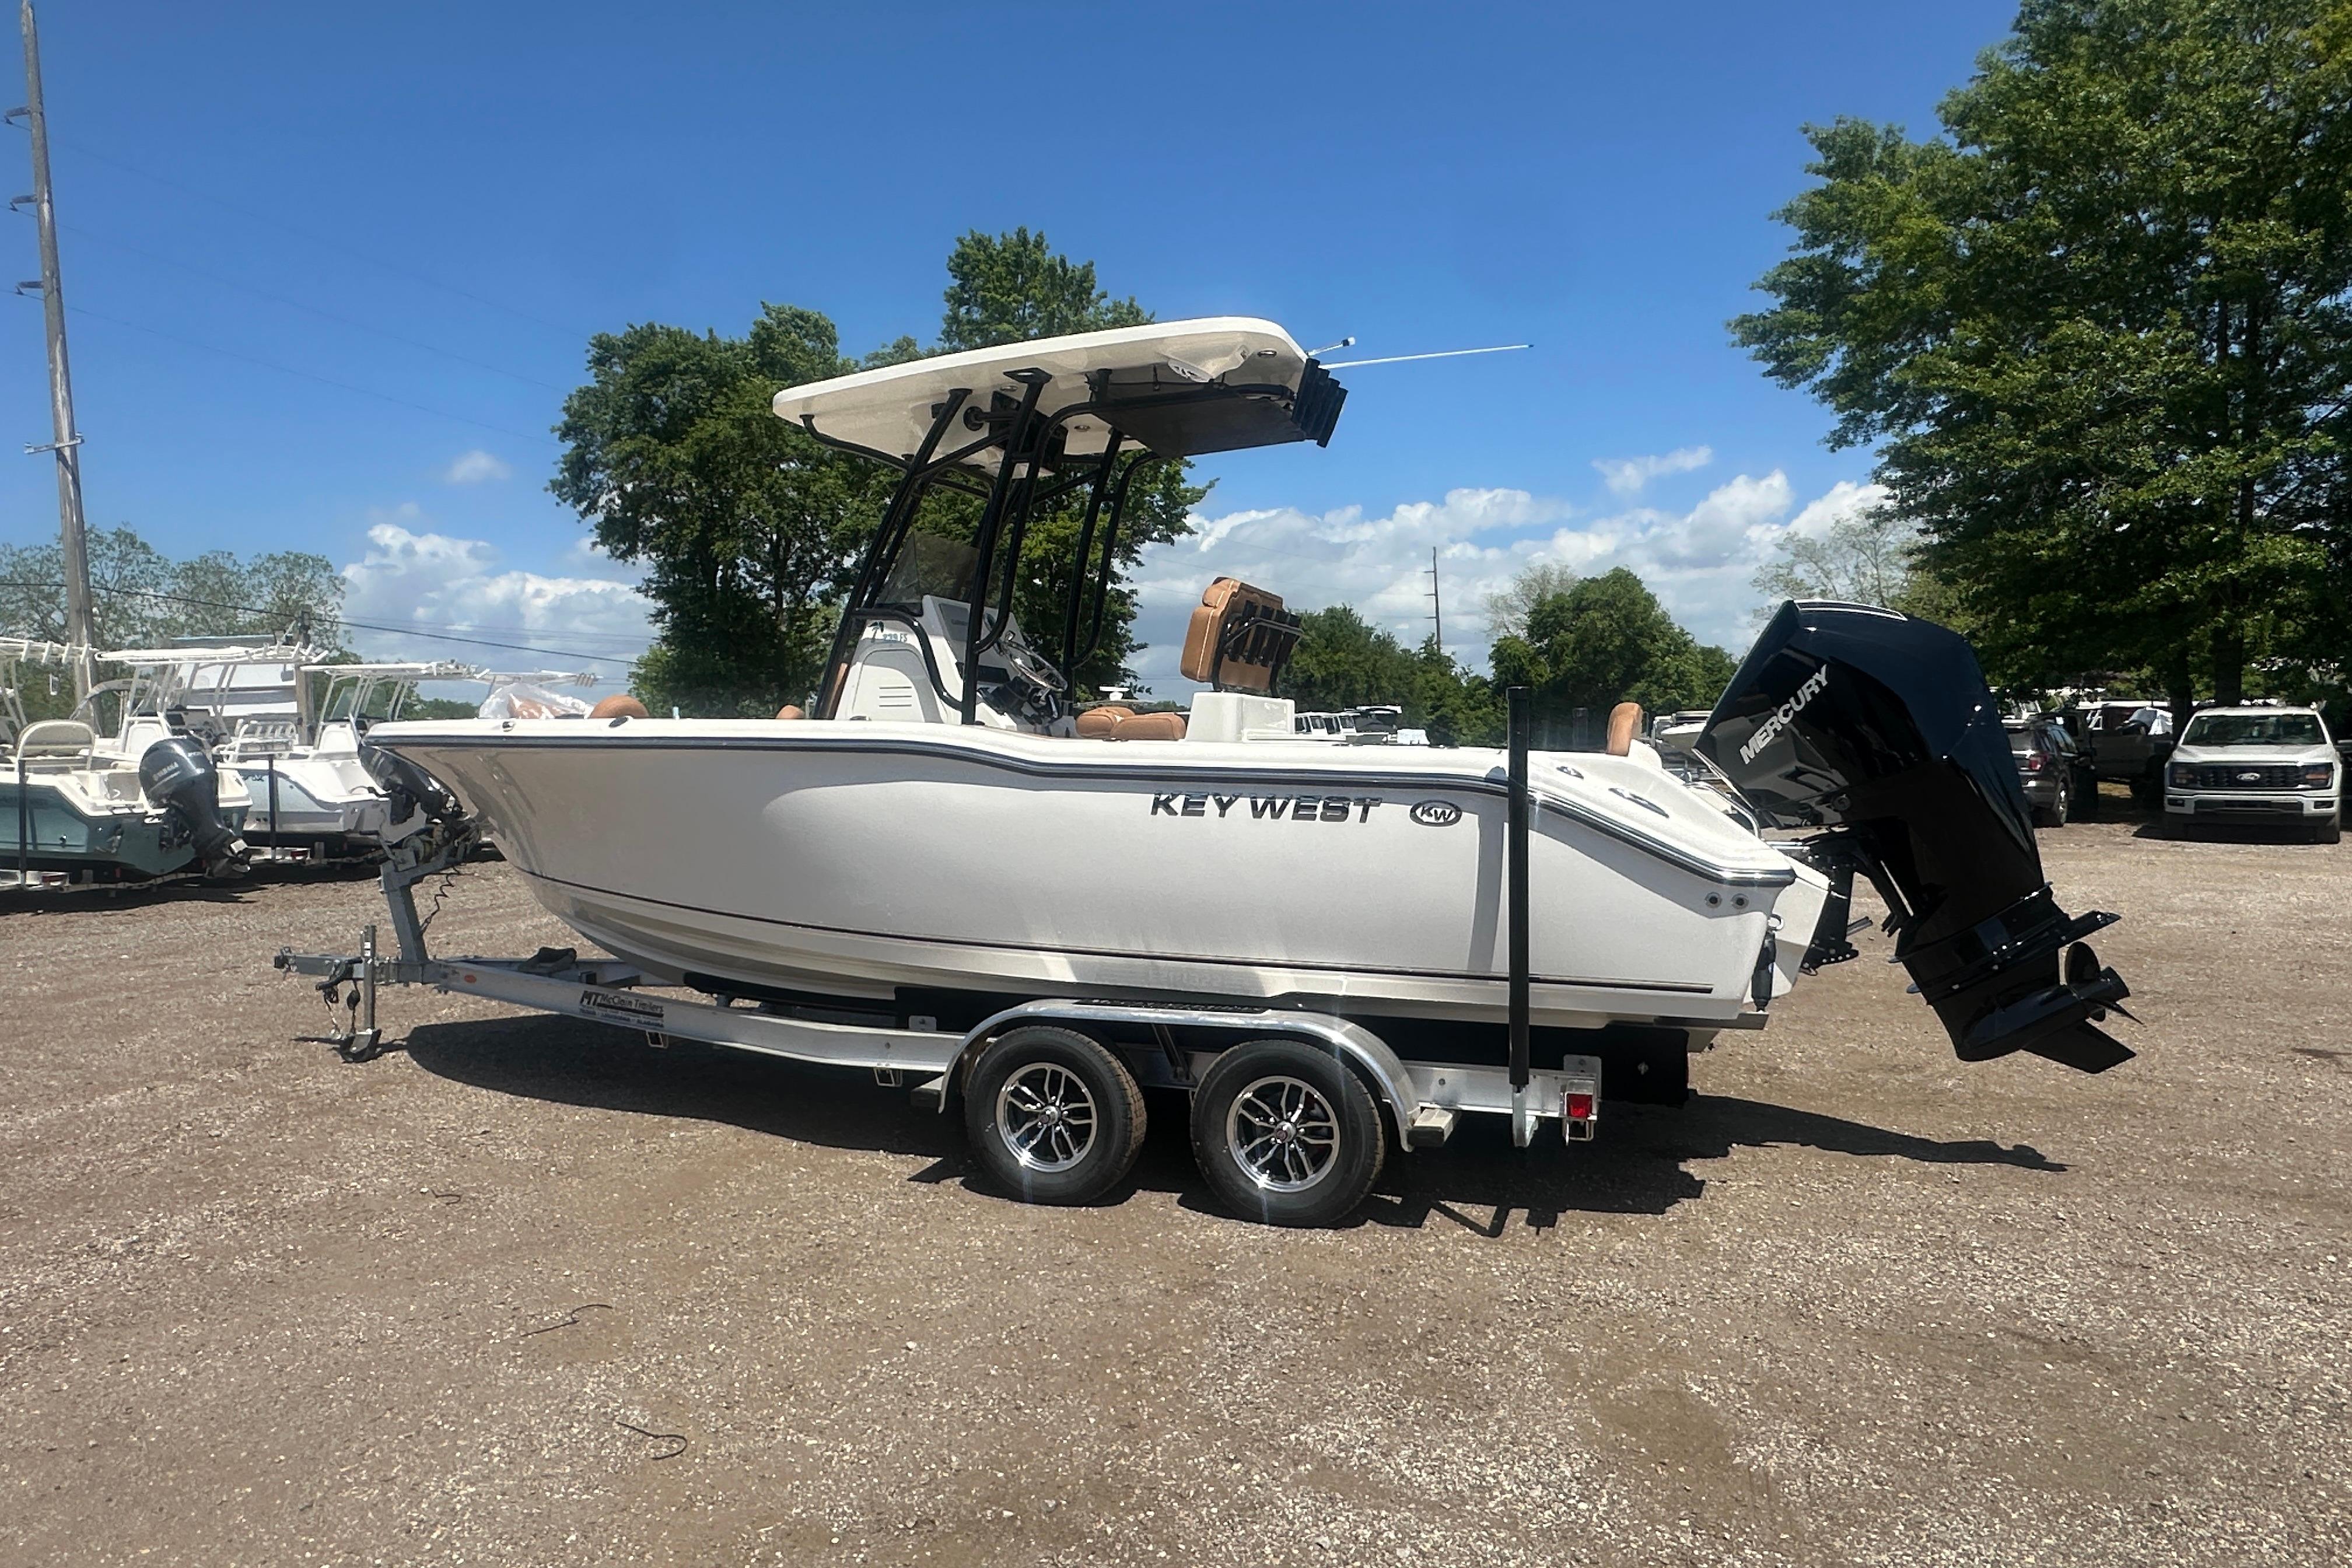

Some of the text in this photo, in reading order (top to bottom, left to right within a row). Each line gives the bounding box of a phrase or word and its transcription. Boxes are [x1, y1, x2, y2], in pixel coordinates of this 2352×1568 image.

[1740, 664, 1828, 764] MERCURY
[1150, 791, 1382, 824] KEY WEST
[1420, 806, 1455, 822] KW
